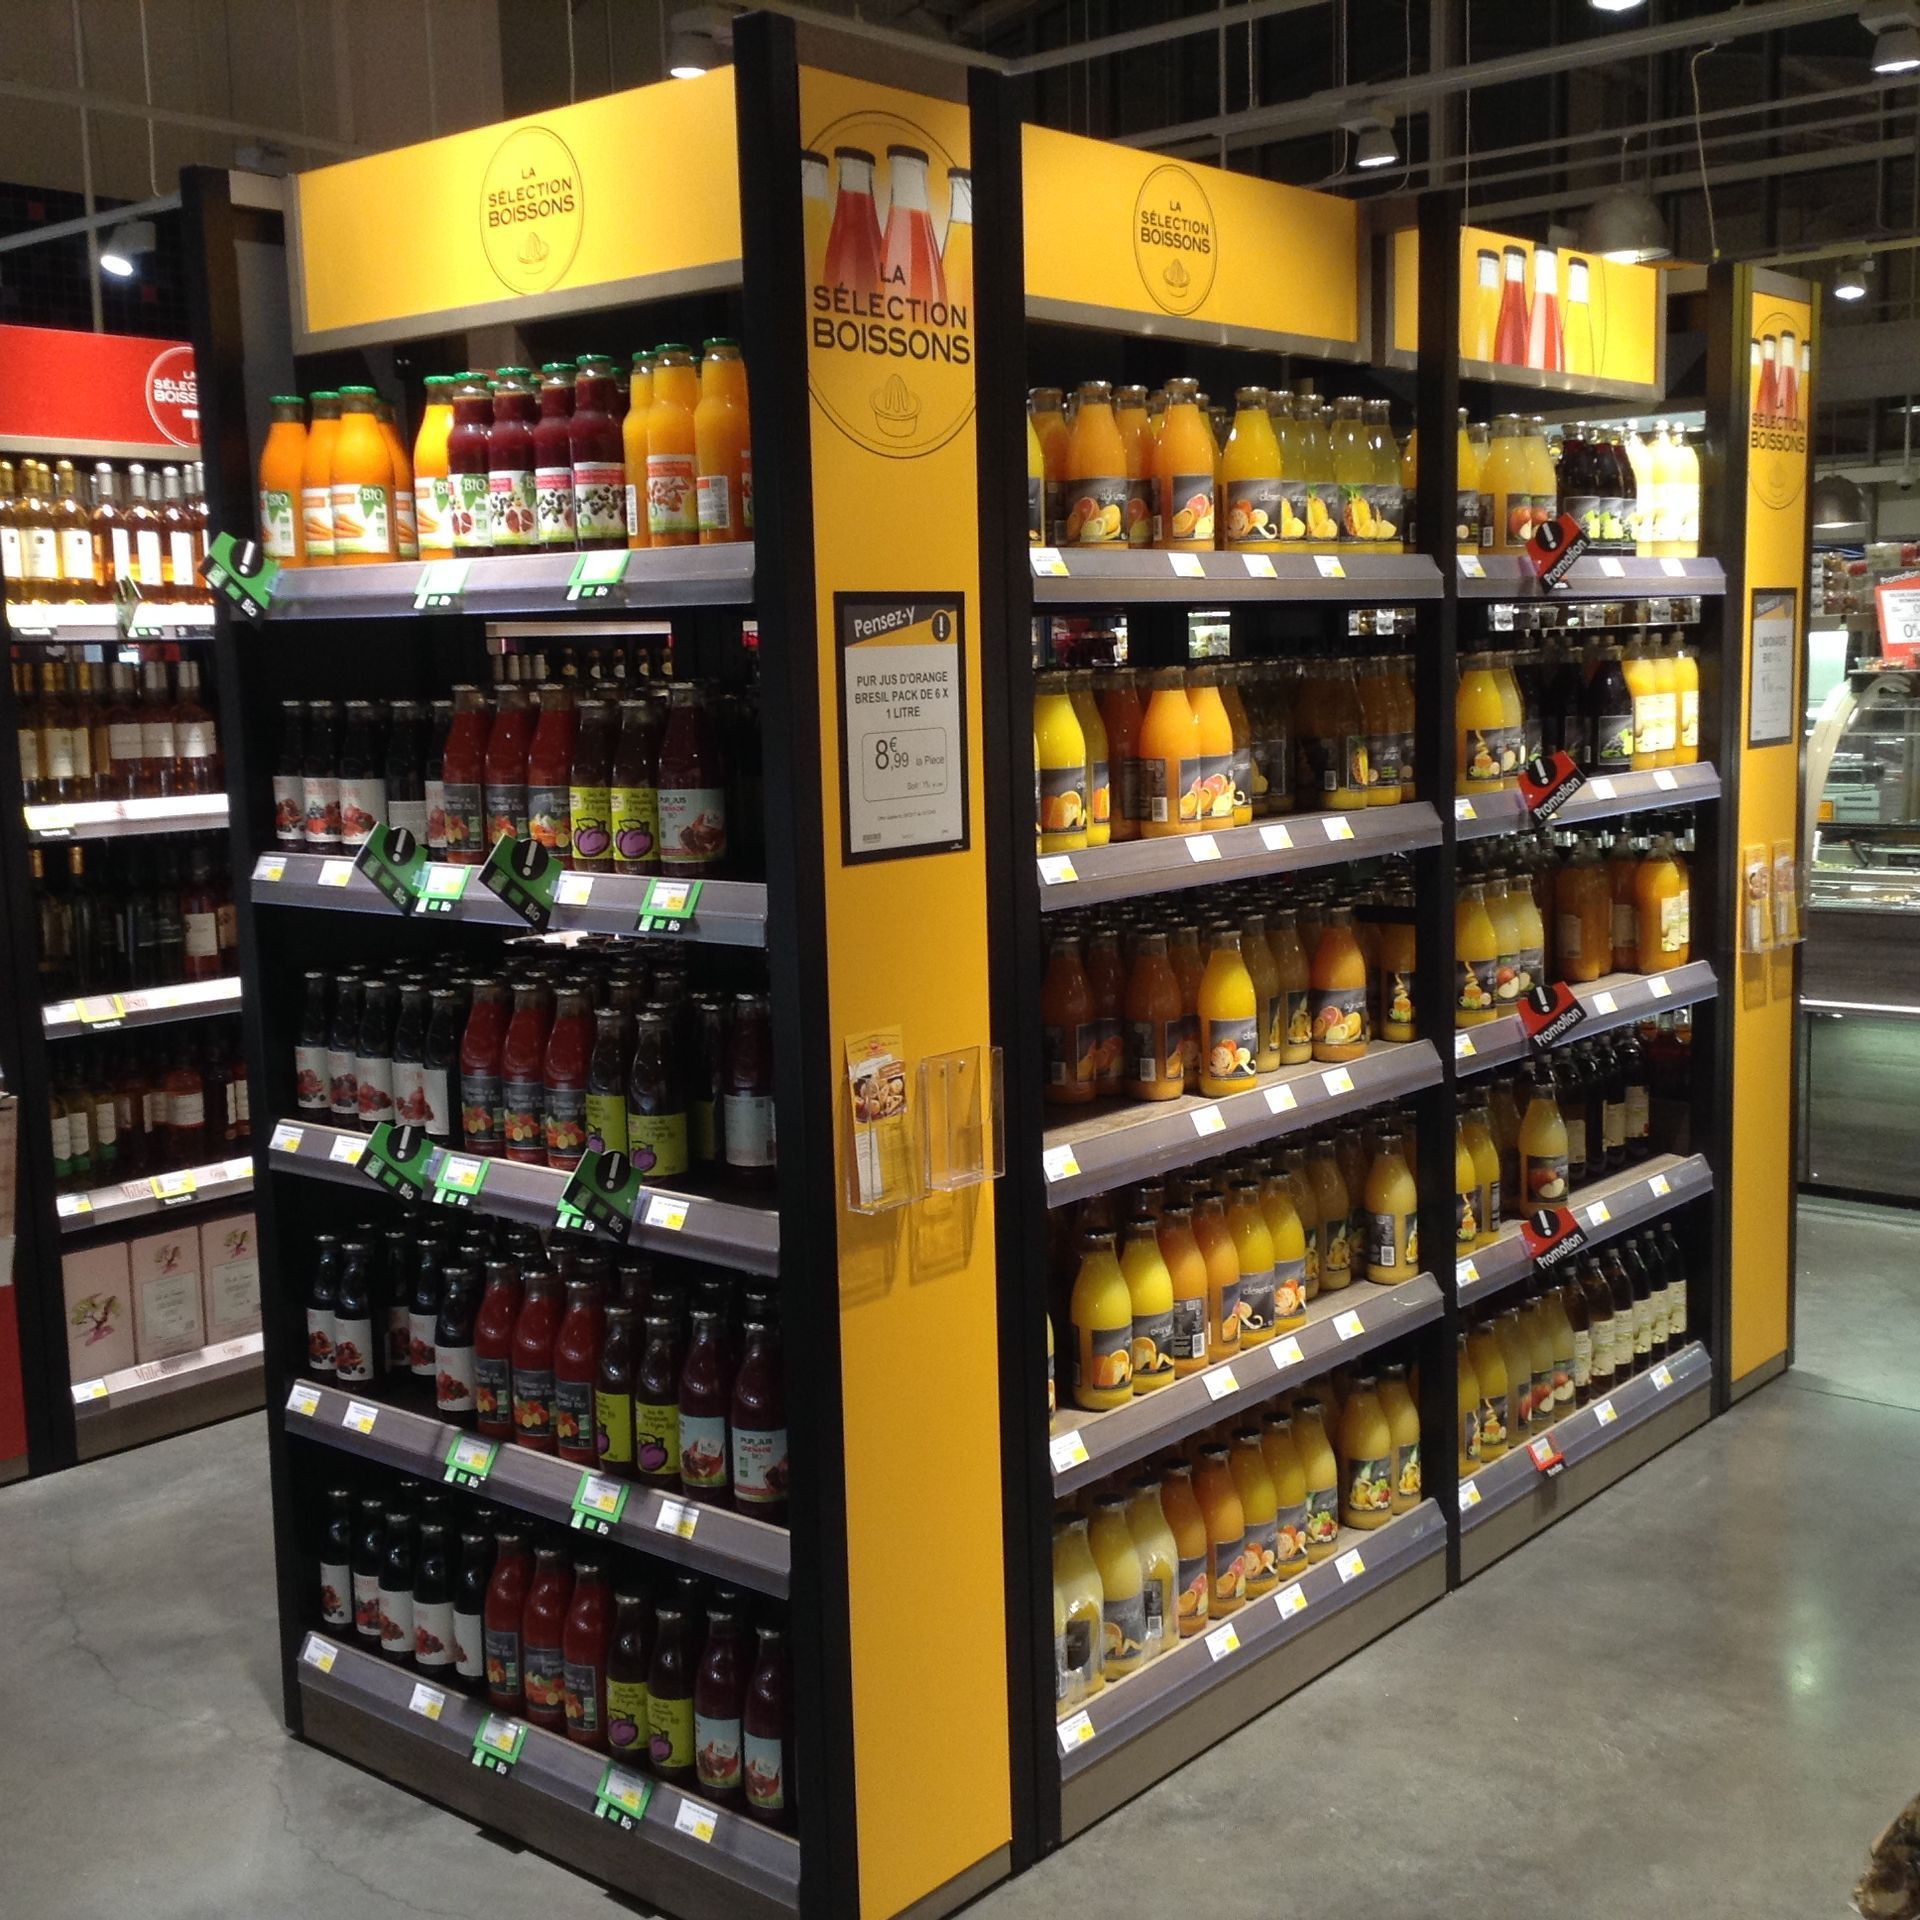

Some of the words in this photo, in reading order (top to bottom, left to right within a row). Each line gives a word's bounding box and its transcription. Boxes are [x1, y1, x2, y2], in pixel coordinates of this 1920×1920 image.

[521, 167, 536, 180] LA
[488, 178, 573, 207] SÉLECTION
[488, 195, 576, 228] BOISSONS
[1169, 200, 1183, 213] LA
[1140, 209, 1210, 235] SÉLECTION
[1140, 226, 1211, 255] BOISSONS
[879, 263, 906, 286] LA
[811, 283, 968, 329] SÉLECTION
[812, 320, 971, 366] BOISSONS
[1751, 431, 1806, 454] BOISSONS
[362, 487, 384, 502] BIO
[464, 478, 486, 492] BIO
[1544, 538, 1588, 587] Promotion
[854, 605, 916, 638] Pensez-y
[857, 673, 877, 687] PUR
[879, 672, 898, 686] JUS
[900, 671, 948, 685] D'ORANGE
[855, 692, 889, 704] BRESIL
[892, 690, 918, 702] PACK
[920, 689, 933, 701] DE
[935, 688, 941, 700] 6
[942, 687, 949, 699] X
[886, 709, 891, 719] 1
[893, 706, 920, 719] LITRE
[1532, 776, 1581, 821] Promotion
[1533, 1007, 1583, 1048] Promotion
[1536, 1232, 1584, 1269] Promotion
